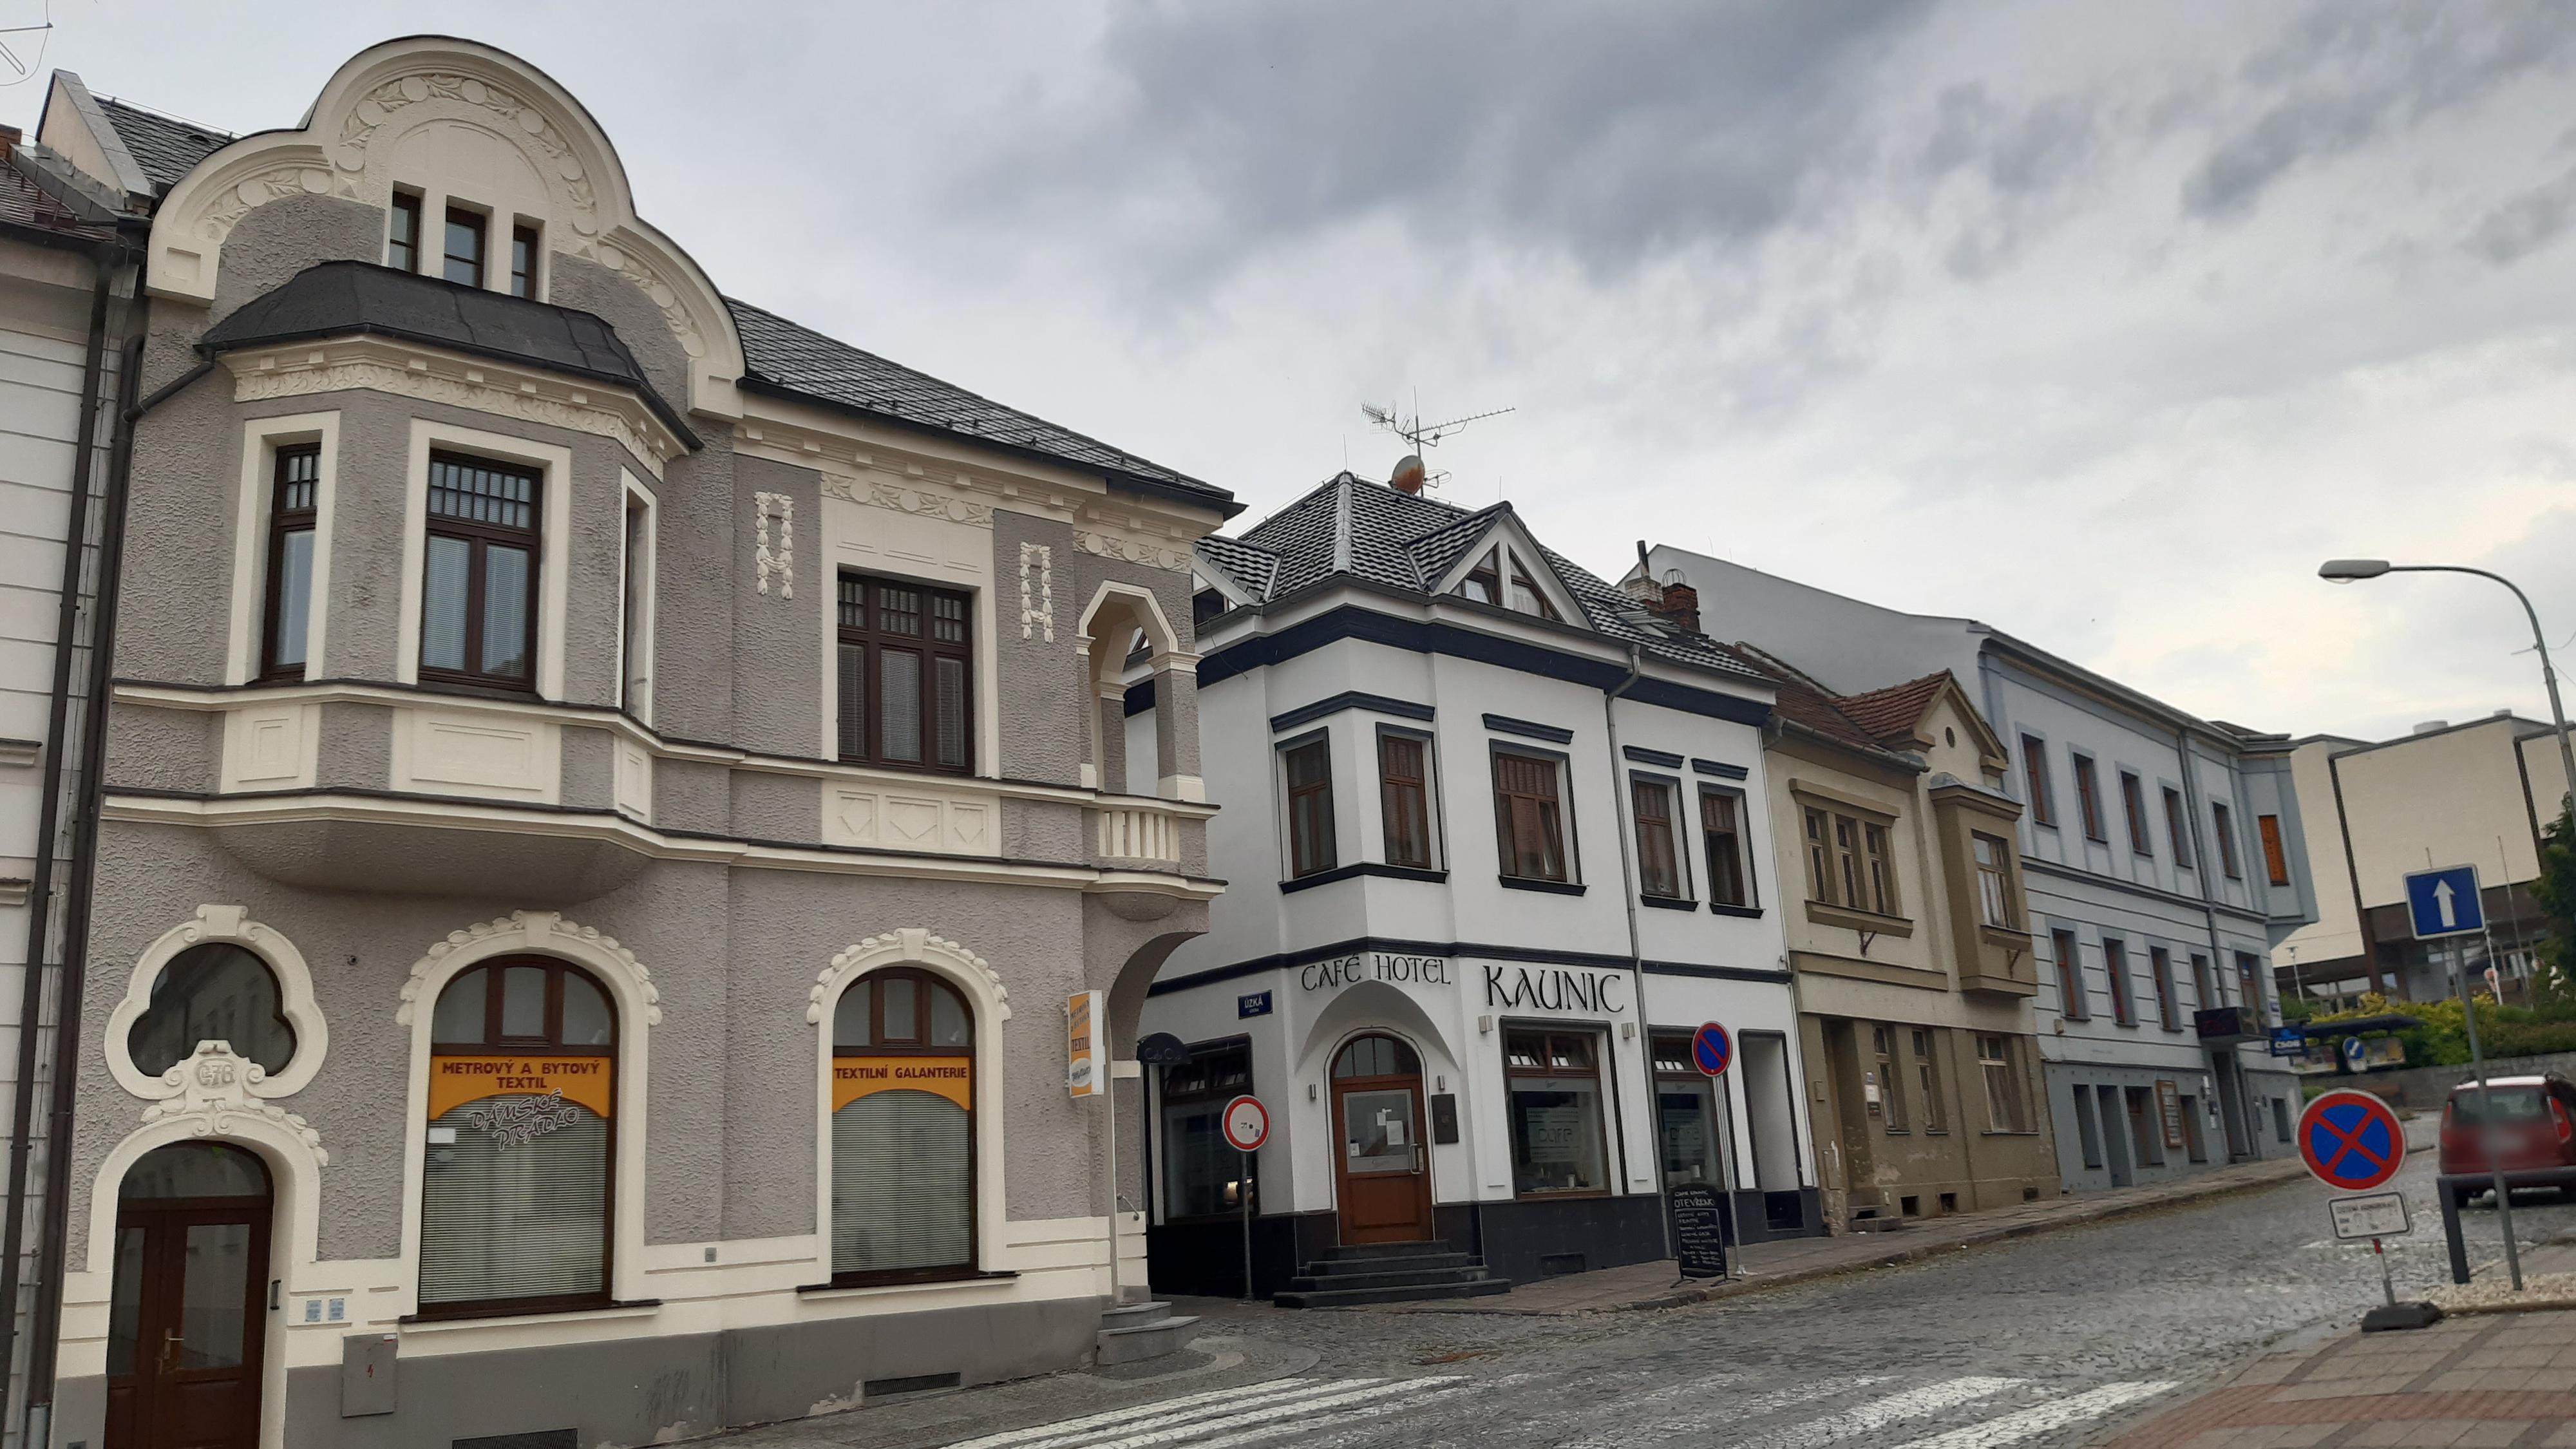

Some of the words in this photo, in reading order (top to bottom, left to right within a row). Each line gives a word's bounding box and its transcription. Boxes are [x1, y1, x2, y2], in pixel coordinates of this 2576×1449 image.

[1301, 953, 1361, 990] CAFÉ
[1375, 954, 1451, 985] HOTEL
[1482, 965, 1624, 1012] KAUNIC
[1072, 1036, 1090, 1052] TEXTIL
[442, 1059, 515, 1074] METROVÝ
[520, 1063, 532, 1074] A
[542, 1059, 600, 1074] BYTOVÝ
[835, 1064, 889, 1079] TEXTILNÍ
[895, 1067, 967, 1079] GALANTERIE
[496, 1077, 547, 1088] TEXTIL
[466, 1087, 563, 1132] DÁMSKÉ
[492, 1106, 580, 1151] PRÁDLO
